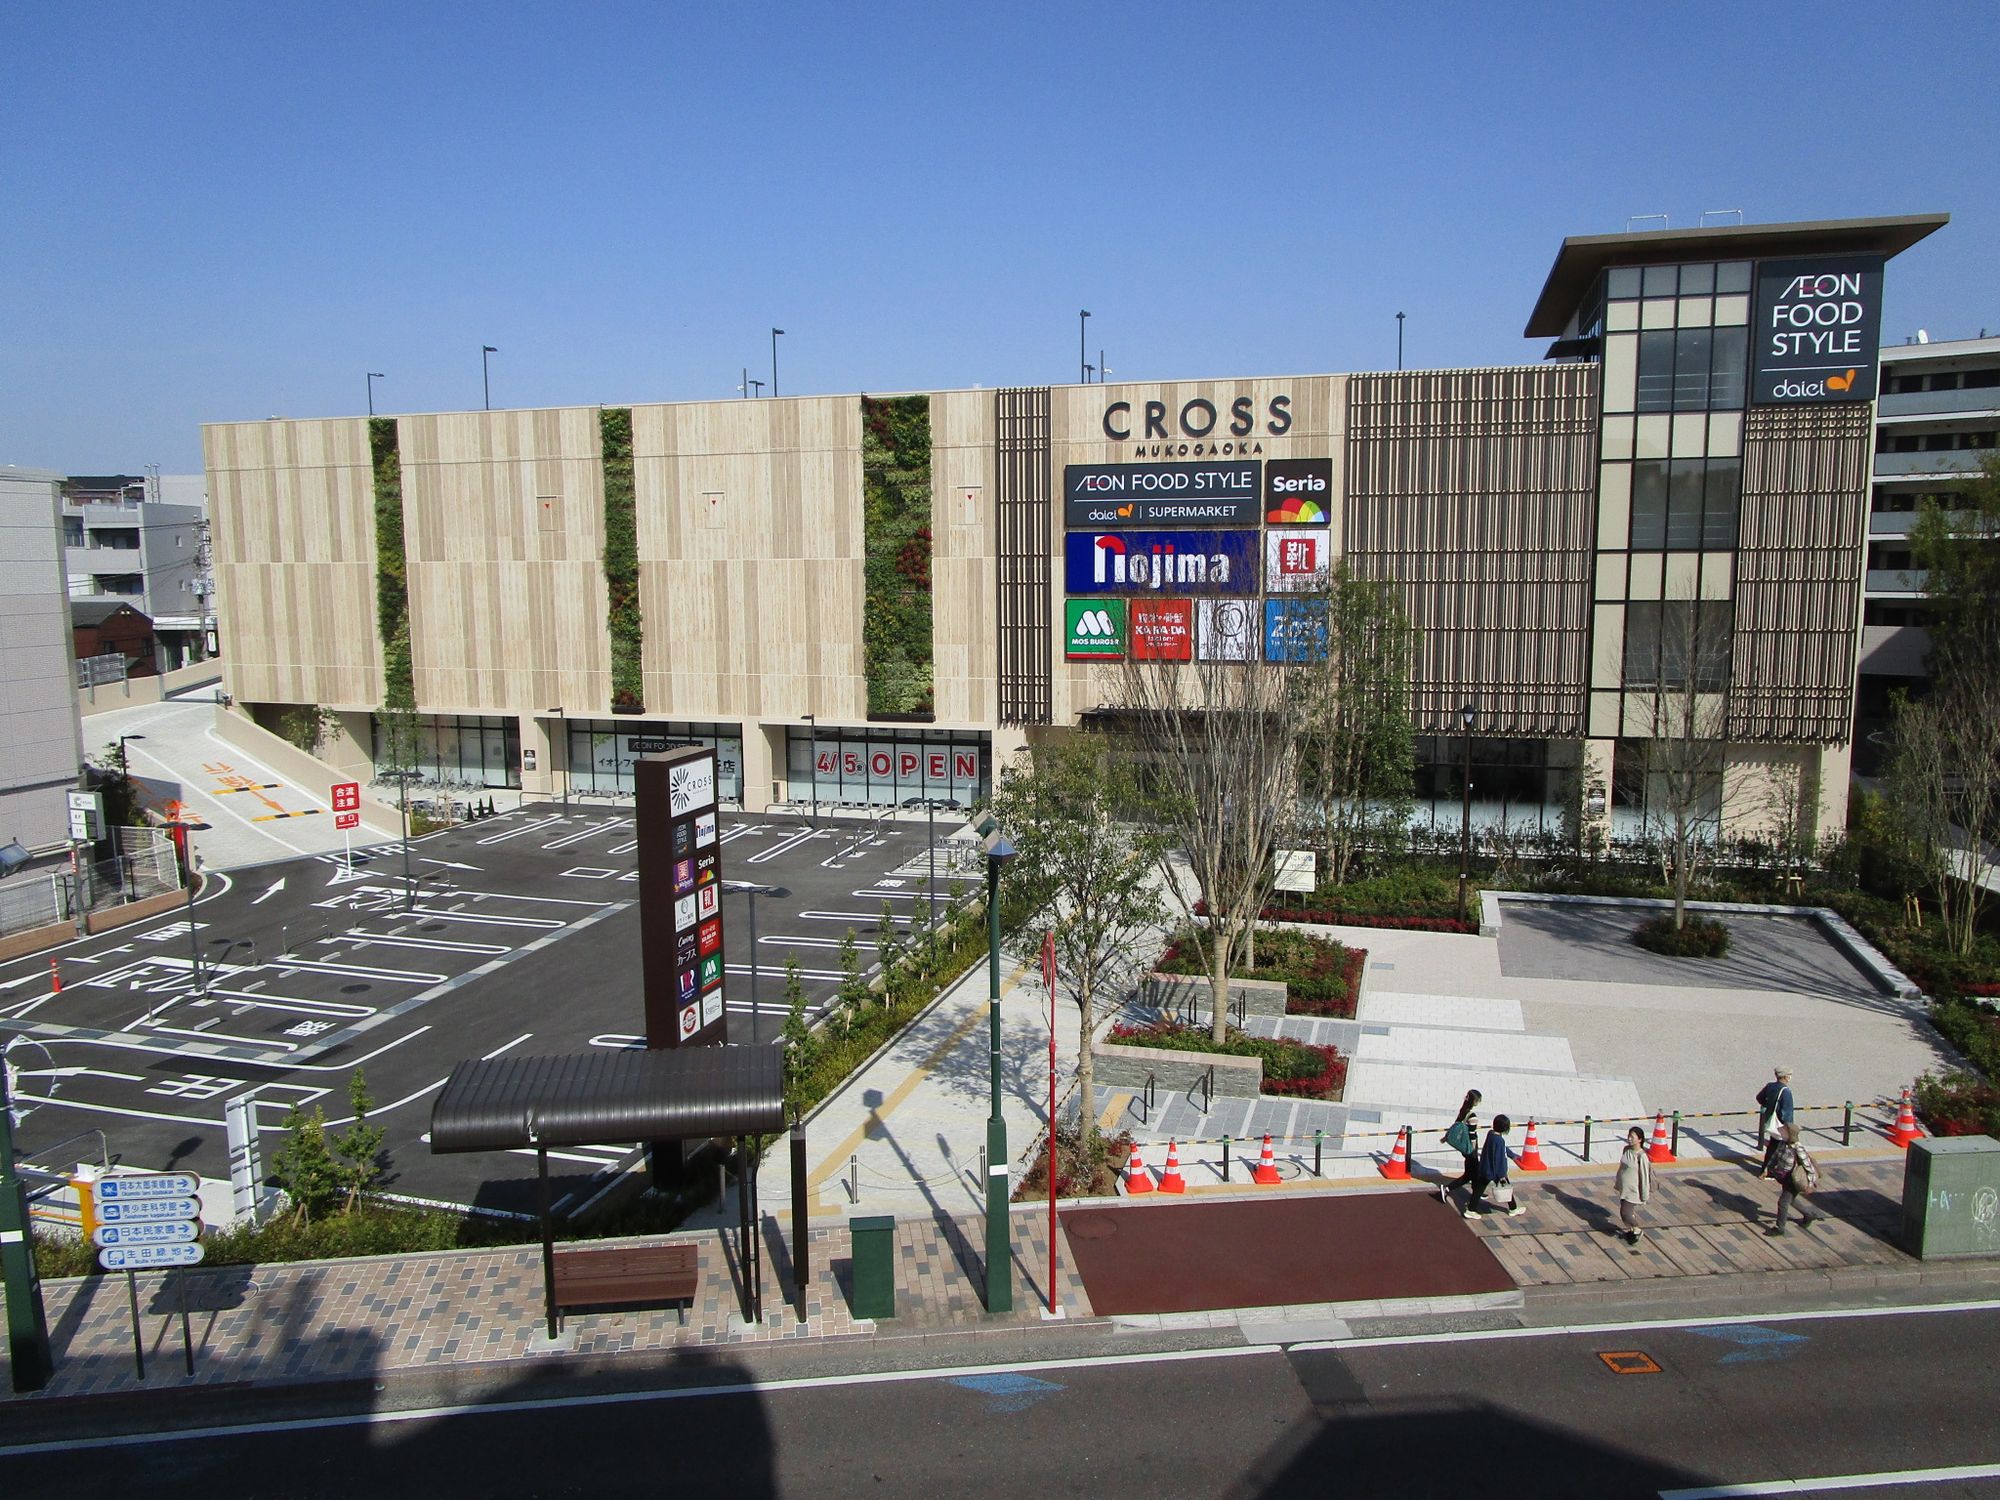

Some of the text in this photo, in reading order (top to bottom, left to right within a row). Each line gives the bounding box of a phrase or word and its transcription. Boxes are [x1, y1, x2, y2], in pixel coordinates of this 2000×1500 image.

[1772, 301, 1863, 328] FOOD
[1771, 329, 1862, 356] STYLE
[1102, 395, 1292, 440] CROSS
[1135, 442, 1263, 458] MUKOGAOKA
[1132, 473, 1189, 490] FOOD
[1194, 471, 1253, 489] STYLE
[1273, 474, 1326, 492] Seria
[1148, 505, 1238, 518] SUPERMARKET
[1071, 637, 1089, 646] MOS
[816, 751, 979, 780] 4/5 OPEN
[687, 776, 712, 791] CROSS
[338, 814, 355, 823] 出口
[698, 854, 715, 870] Seria
[121, 1225, 175, 1236] 日本民家園
[127, 1248, 181, 1258] 生田緑地
